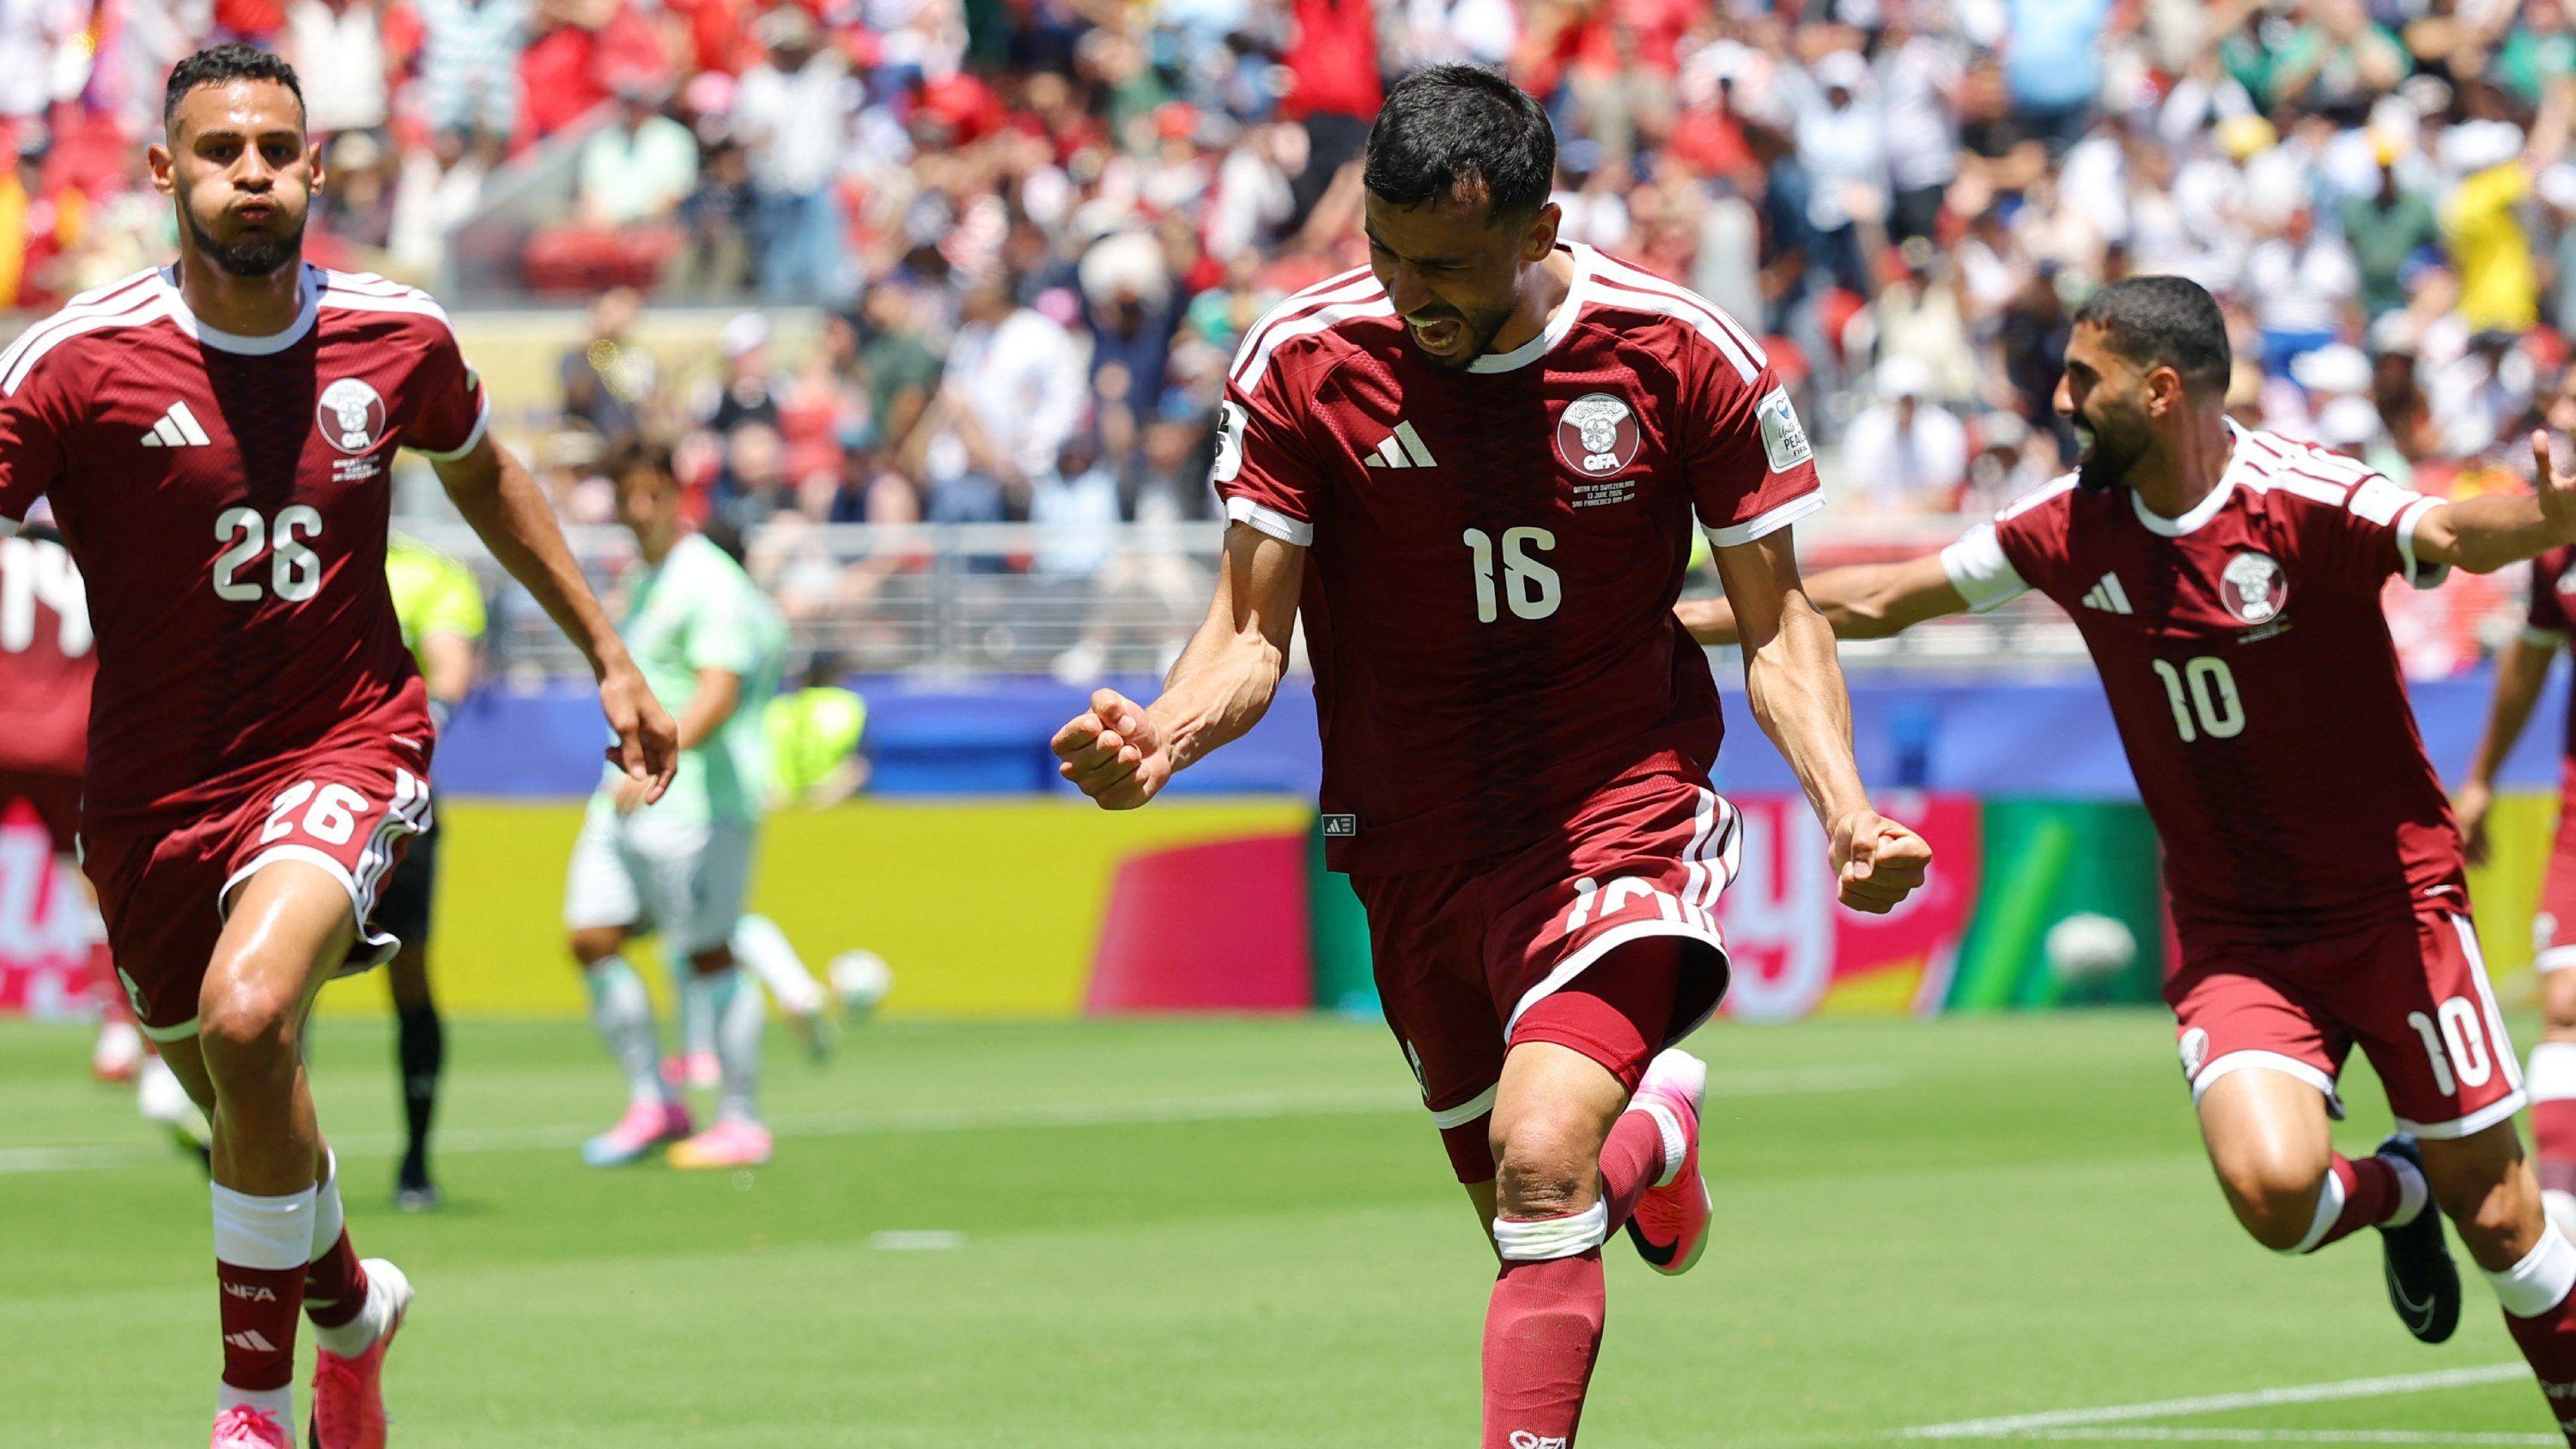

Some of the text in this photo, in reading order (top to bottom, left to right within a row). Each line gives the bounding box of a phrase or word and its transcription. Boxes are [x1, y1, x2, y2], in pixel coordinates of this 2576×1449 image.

[1583, 452, 1620, 470] QFA
[1784, 431, 1805, 450] PEAC
[1584, 498, 1611, 506] FRANCISCO
[1600, 480, 1635, 491] SWITZERLAND
[214, 505, 322, 603] 26
[1464, 527, 1562, 623] 16
[0, 536, 94, 658] 14
[2152, 657, 2246, 743] 10
[259, 779, 369, 845] 26
[2407, 996, 2492, 1097] 10
